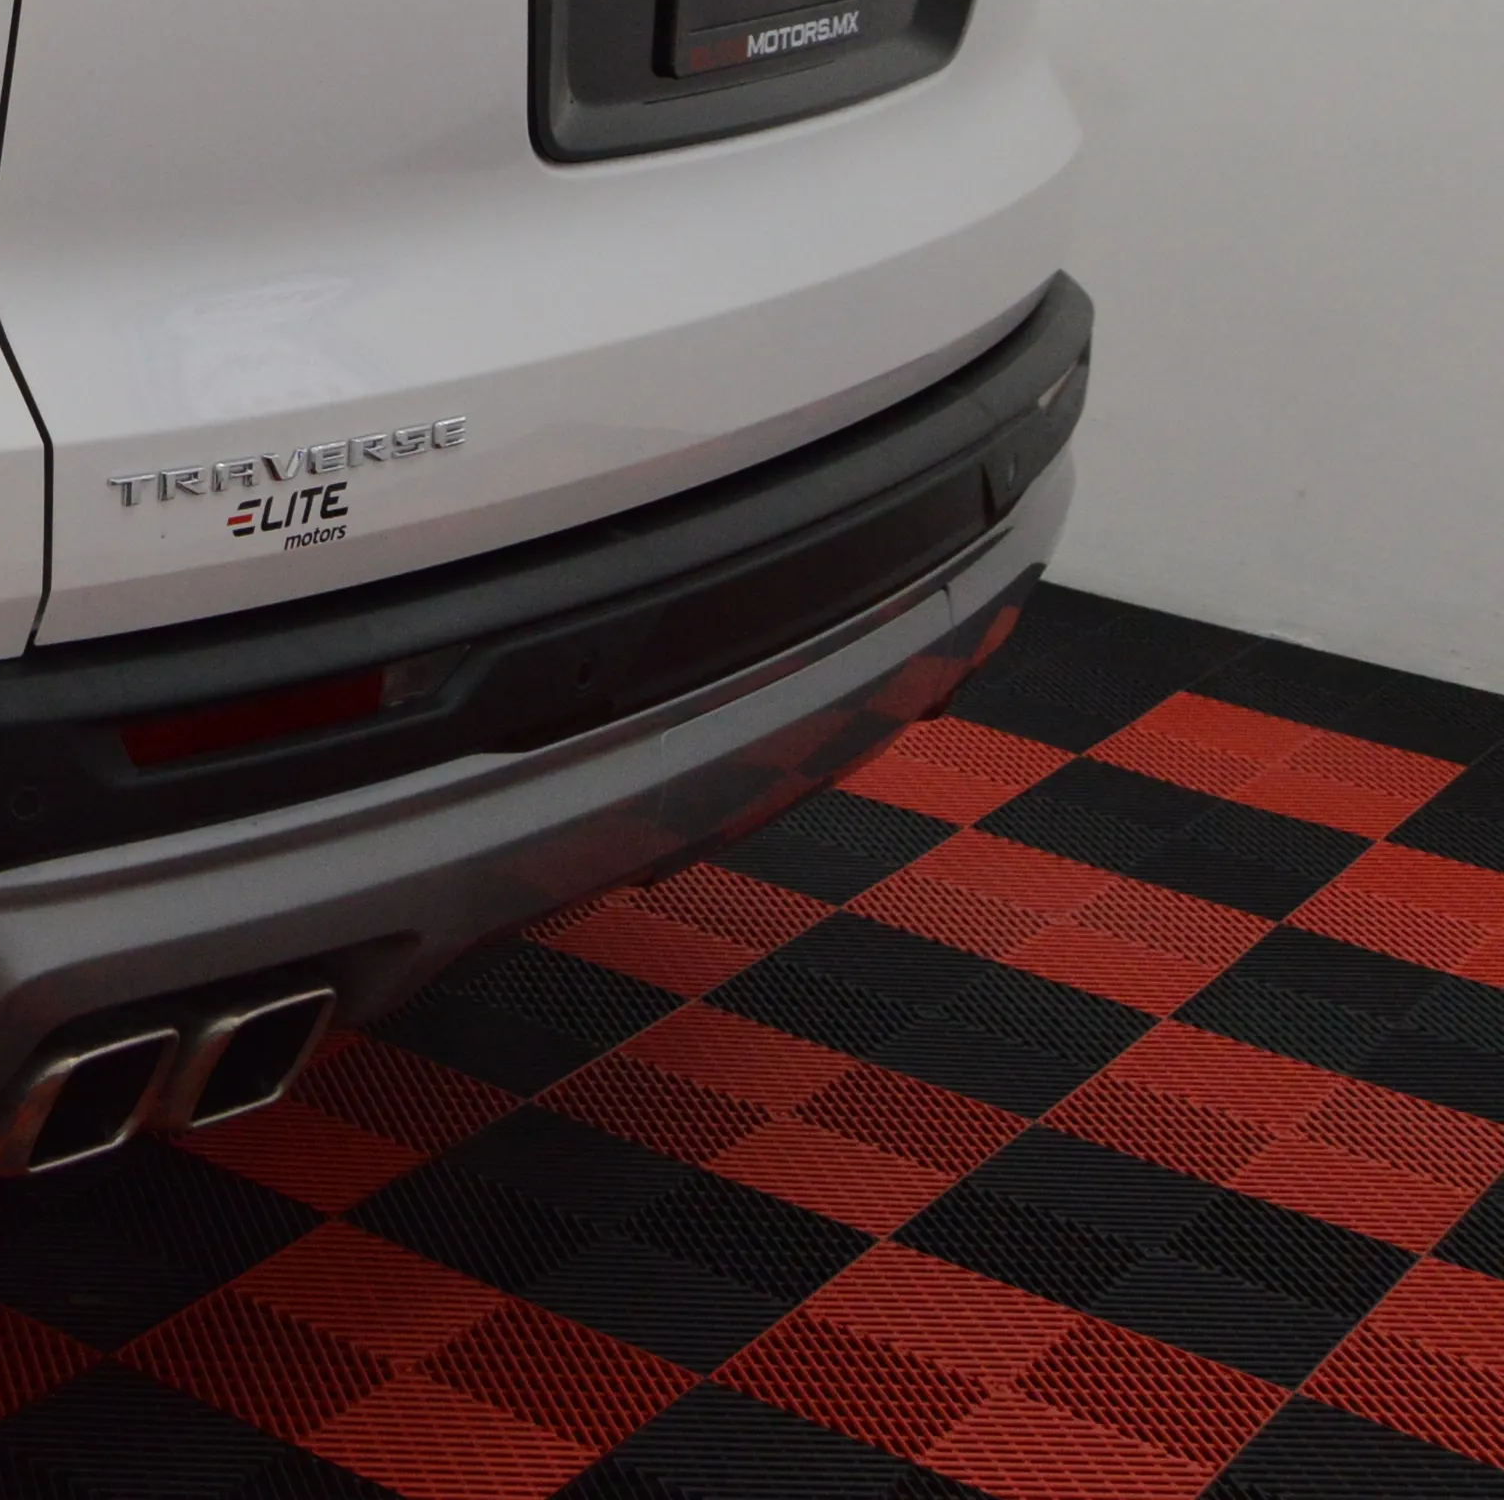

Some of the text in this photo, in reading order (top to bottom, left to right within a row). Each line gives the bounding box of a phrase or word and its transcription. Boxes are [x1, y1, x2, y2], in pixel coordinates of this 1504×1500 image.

[106, 414, 468, 508] TRAVERSE
[226, 481, 350, 538] ELITE
[282, 523, 348, 552] motors
